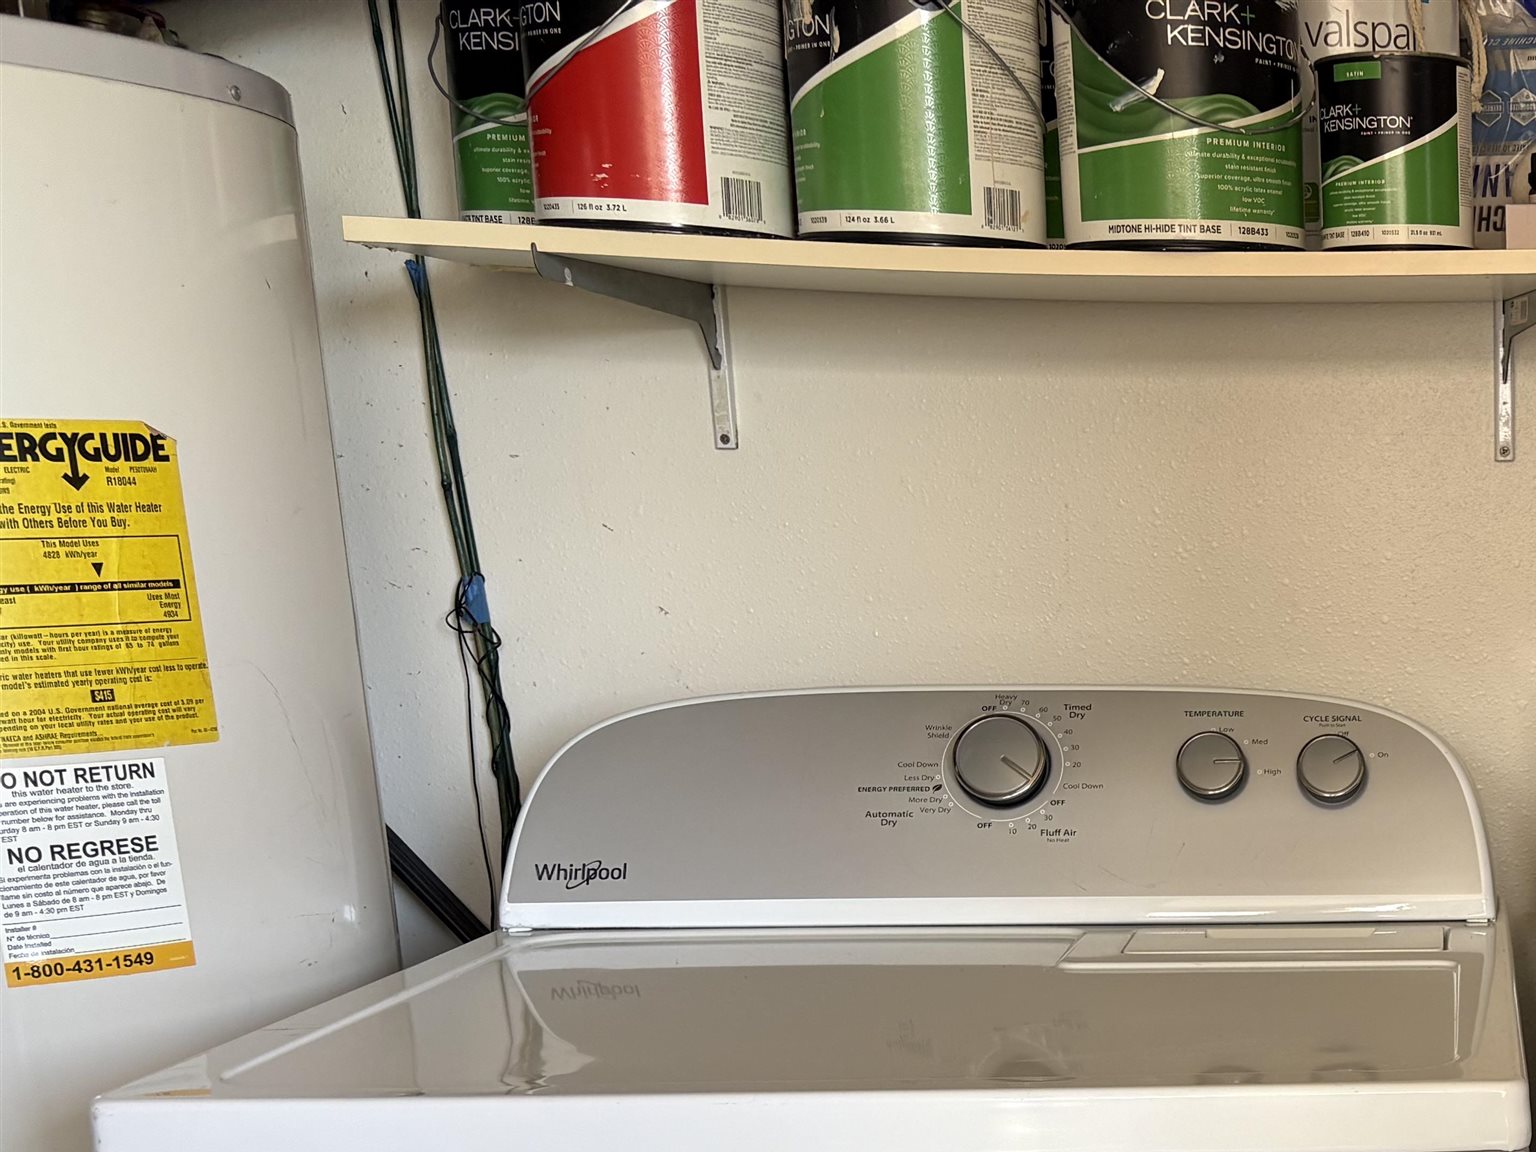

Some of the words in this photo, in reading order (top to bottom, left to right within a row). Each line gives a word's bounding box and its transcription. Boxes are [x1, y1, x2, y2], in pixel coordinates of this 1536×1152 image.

[487, 133, 525, 142] PREMIUM
[1207, 138, 1249, 147] PREMIUM
[845, 216, 857, 224] 124
[874, 215, 889, 224] 3.66
[1108, 224, 1142, 234] MIDTONE
[1144, 223, 1176, 233] HI-HIDE
[1179, 224, 1198, 234] TINT
[1200, 225, 1222, 234] BASE
[1238, 226, 1269, 236] 128B433
[106, 477, 137, 486] R18044
[18, 502, 51, 516] Energy
[54, 503, 73, 514] Use
[75, 502, 84, 514] of
[87, 502, 104, 513] this
[108, 502, 132, 514] Water
[135, 502, 162, 513] Heater
[22, 517, 54, 529] Others
[58, 517, 88, 528] Before
[91, 517, 108, 528] You
[110, 516, 130, 529] Buy.
[41, 540, 56, 549] This
[59, 540, 81, 548] Model
[82, 539, 99, 547] Uses
[43, 551, 60, 559] 4828
[1064, 703, 1092, 711] Timed
[1069, 711, 1086, 720] Dry
[23, 768, 66, 788] NOT
[74, 762, 155, 785] RETURN
[11, 790, 27, 798] this
[29, 789, 53, 797] water
[56, 786, 83, 795] heater
[95, 784, 109, 792] the
[111, 782, 134, 790] store.
[927, 797, 943, 805] Dry
[865, 810, 914, 818] Automatic
[880, 818, 898, 827] Dry
[1040, 829, 1060, 837] Fluff
[1062, 829, 1077, 837] Air
[7, 846, 43, 865] NO
[50, 835, 159, 861] REGRESE
[28, 861, 74, 871] calentador
[89, 858, 110, 868] agua
[128, 853, 156, 862] tienda.
[535, 860, 627, 889] Whirlpool
[12, 951, 154, 981] 1-800-431-1549
